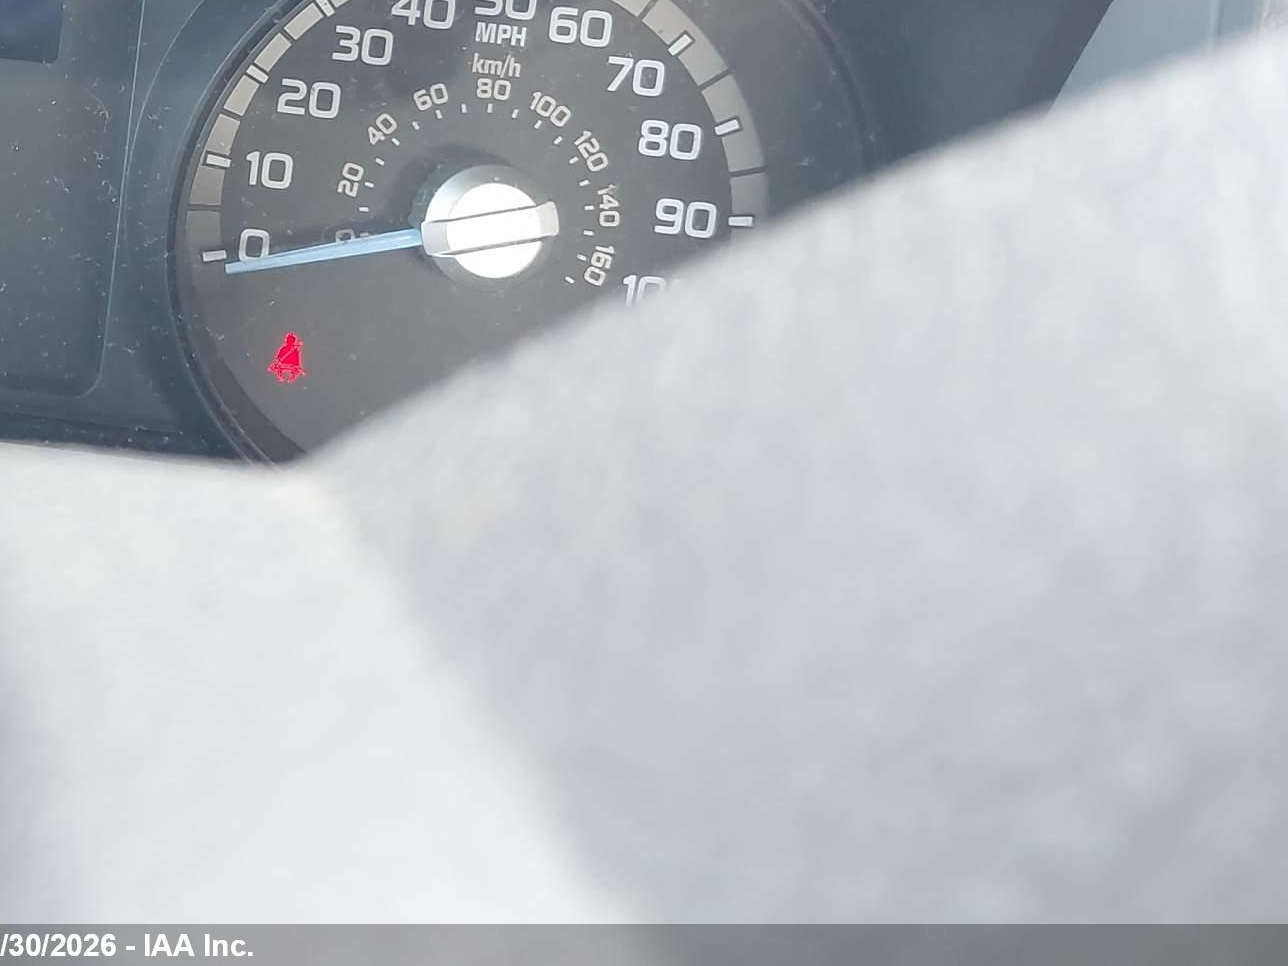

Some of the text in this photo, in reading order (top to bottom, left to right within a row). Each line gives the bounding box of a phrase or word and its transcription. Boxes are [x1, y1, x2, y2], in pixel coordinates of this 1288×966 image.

[333, 25, 393, 66] 30
[475, 22, 527, 47] MPH
[549, 6, 613, 47] 60
[472, 52, 521, 78] km/h
[607, 56, 665, 97] 70
[277, 79, 342, 119] 20
[413, 83, 449, 111] 60
[476, 78, 511, 101] 80
[530, 91, 572, 127] 100
[367, 113, 398, 146] 40
[638, 120, 702, 161] 80
[246, 151, 293, 189] 10
[574, 130, 609, 172] 120
[337, 162, 365, 197] 20
[597, 184, 621, 227] 140
[654, 198, 718, 239] 90
[238, 228, 270, 263] 0
[583, 245, 615, 286] 160
